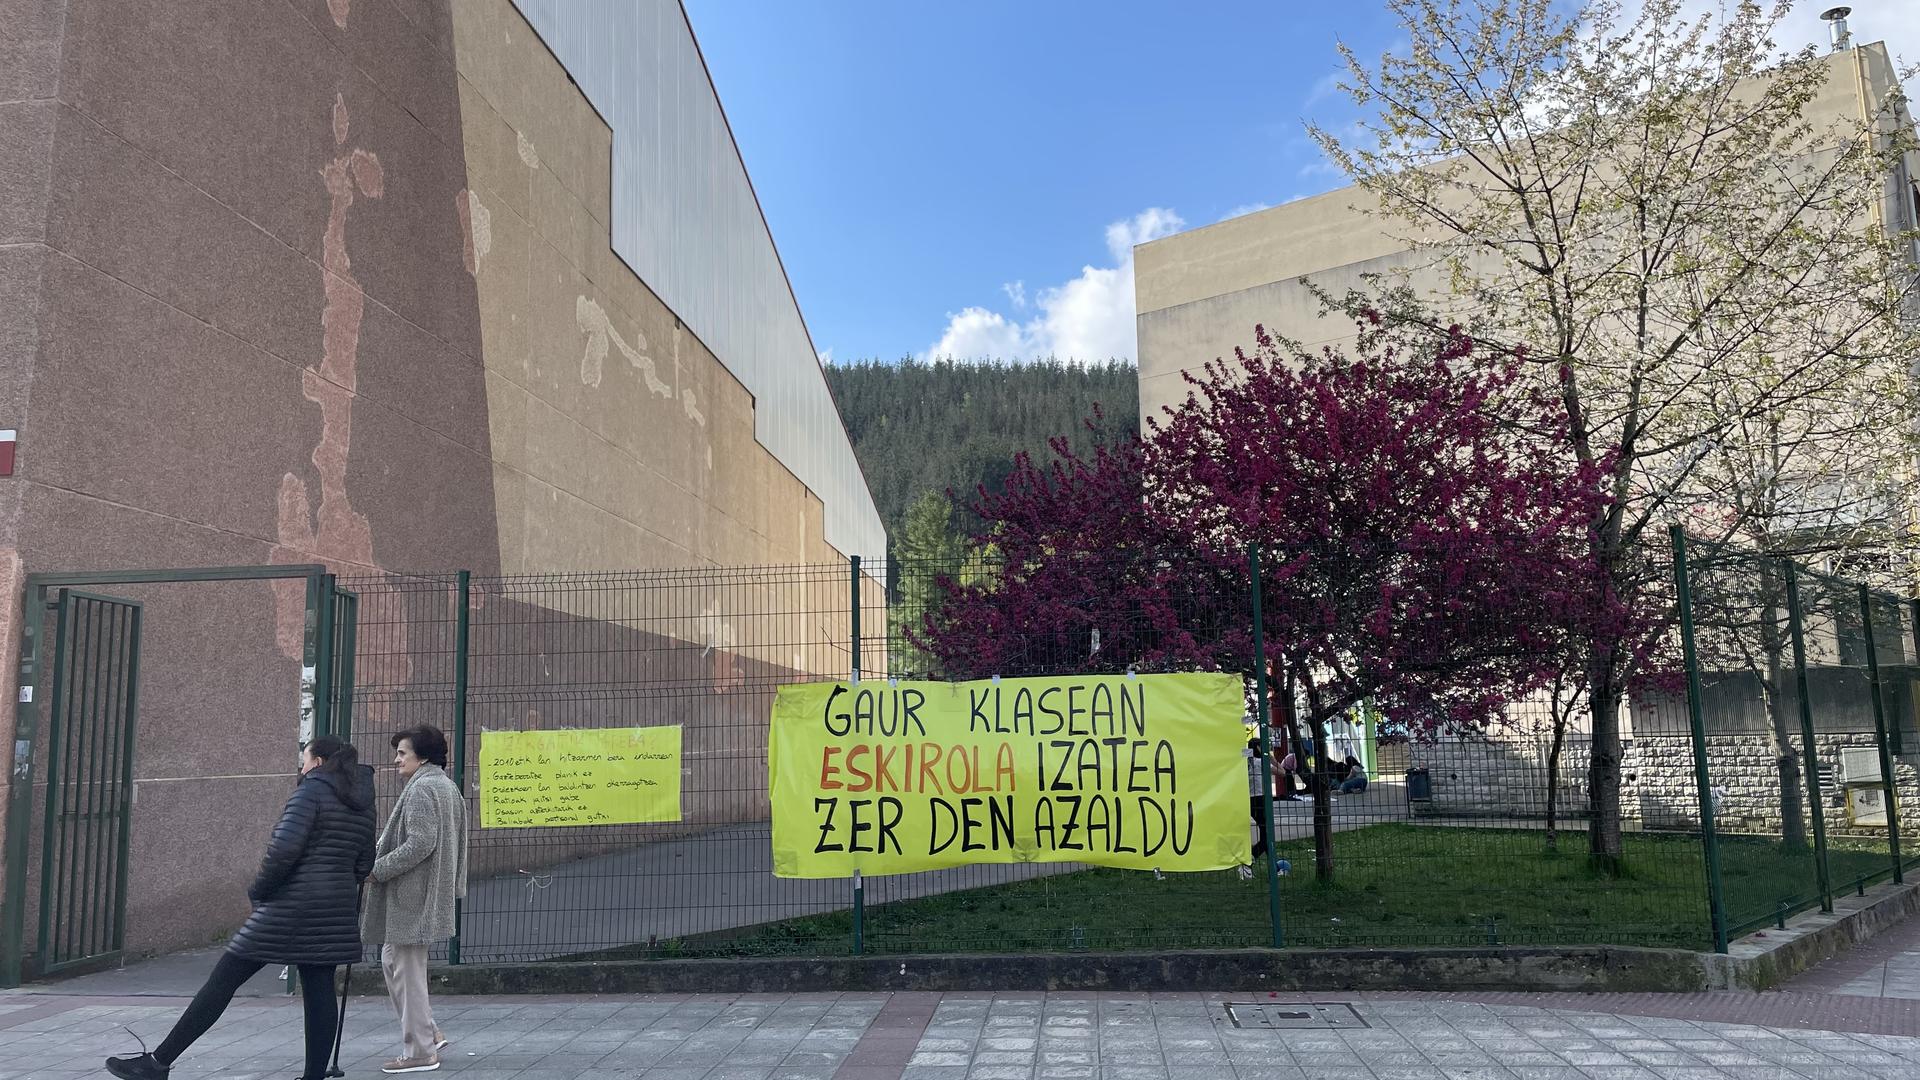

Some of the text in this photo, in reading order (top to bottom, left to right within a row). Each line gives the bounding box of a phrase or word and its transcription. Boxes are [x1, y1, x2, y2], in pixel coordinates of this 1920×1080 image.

[824, 682, 1146, 737] GAUR KLASEAN
[538, 754, 551, 765] lan
[538, 782, 550, 791] lan
[820, 737, 1176, 795] ESKIROLA IZATEA
[814, 794, 1194, 857] ZER DEN AZALDU
